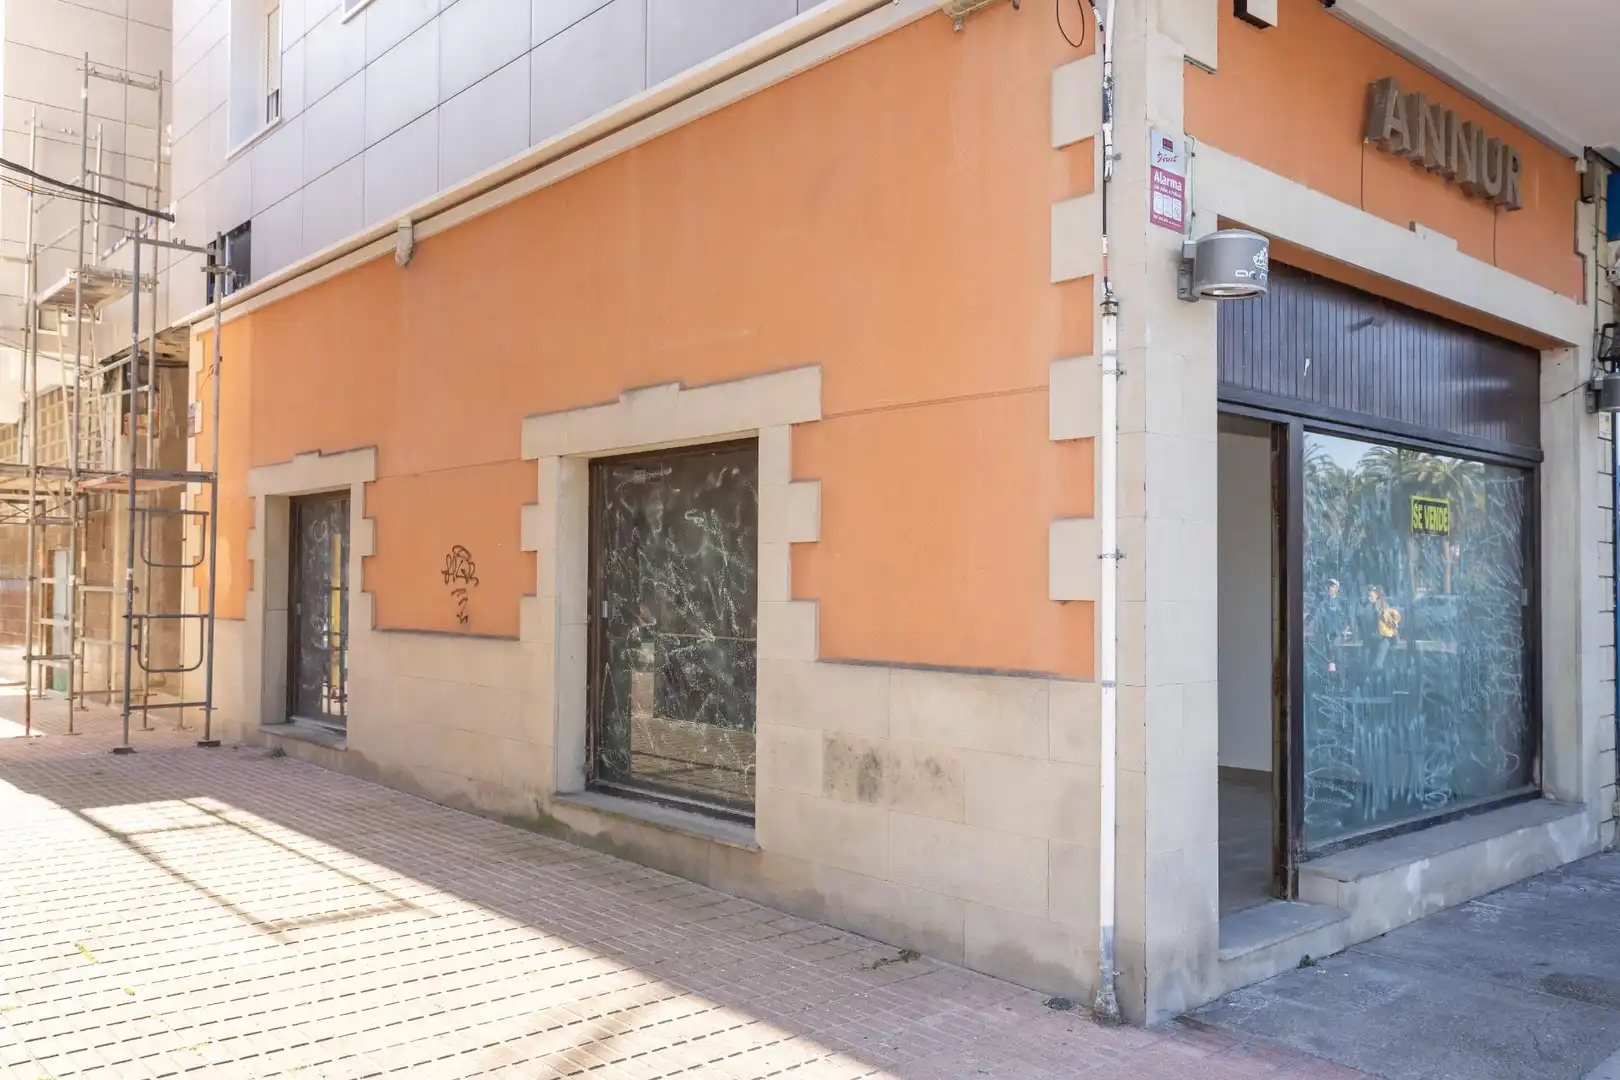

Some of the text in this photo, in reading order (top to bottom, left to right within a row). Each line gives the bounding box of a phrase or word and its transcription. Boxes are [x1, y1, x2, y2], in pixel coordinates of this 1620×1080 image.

[1370, 77, 1522, 210] ANNUR
[1153, 170, 1182, 191] Alarma
[1413, 503, 1448, 532] SE VENDE
